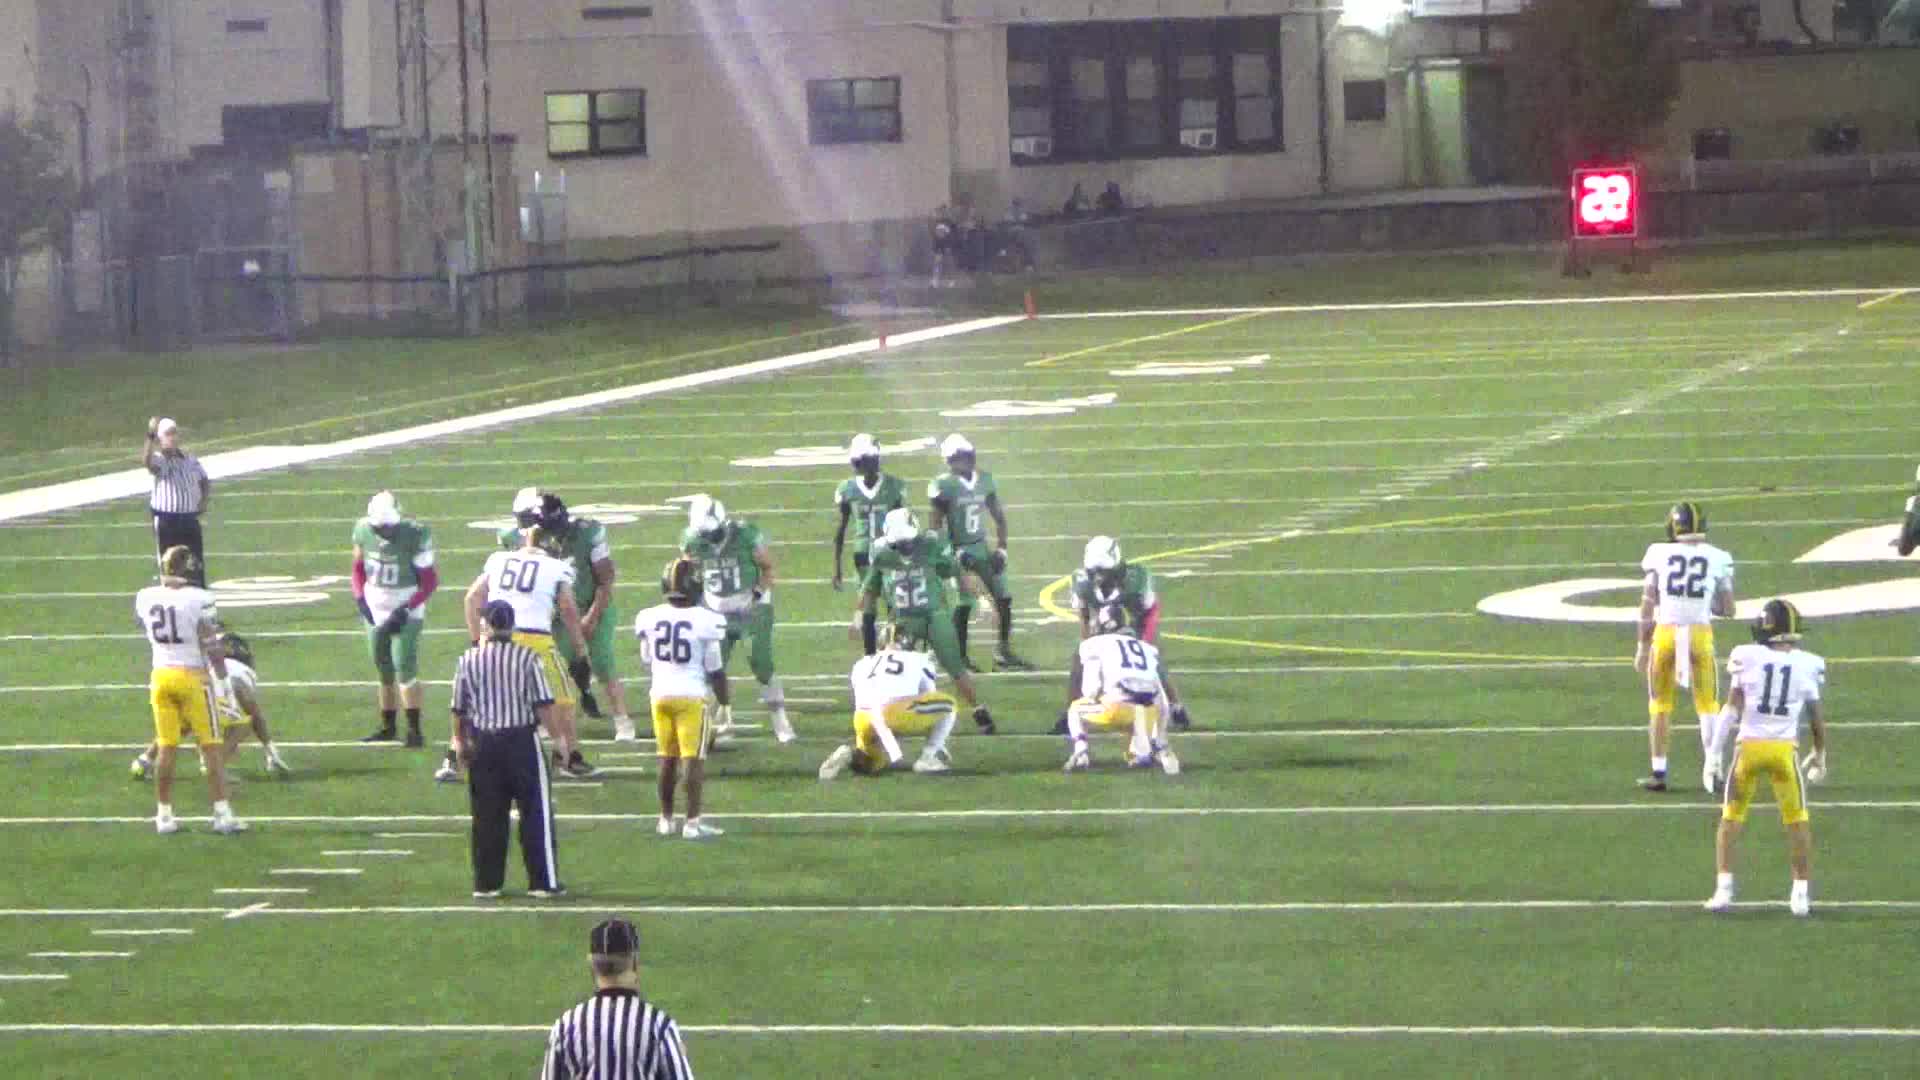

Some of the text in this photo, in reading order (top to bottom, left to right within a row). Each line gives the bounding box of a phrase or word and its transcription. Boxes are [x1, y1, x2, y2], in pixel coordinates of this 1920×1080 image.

[965, 505, 980, 533] 6
[500, 558, 540, 593] 60
[1667, 554, 1709, 598] 22
[149, 604, 184, 644] 21
[654, 620, 693, 664] 26
[1116, 639, 1148, 670] 19
[1757, 662, 1793, 716] 11
